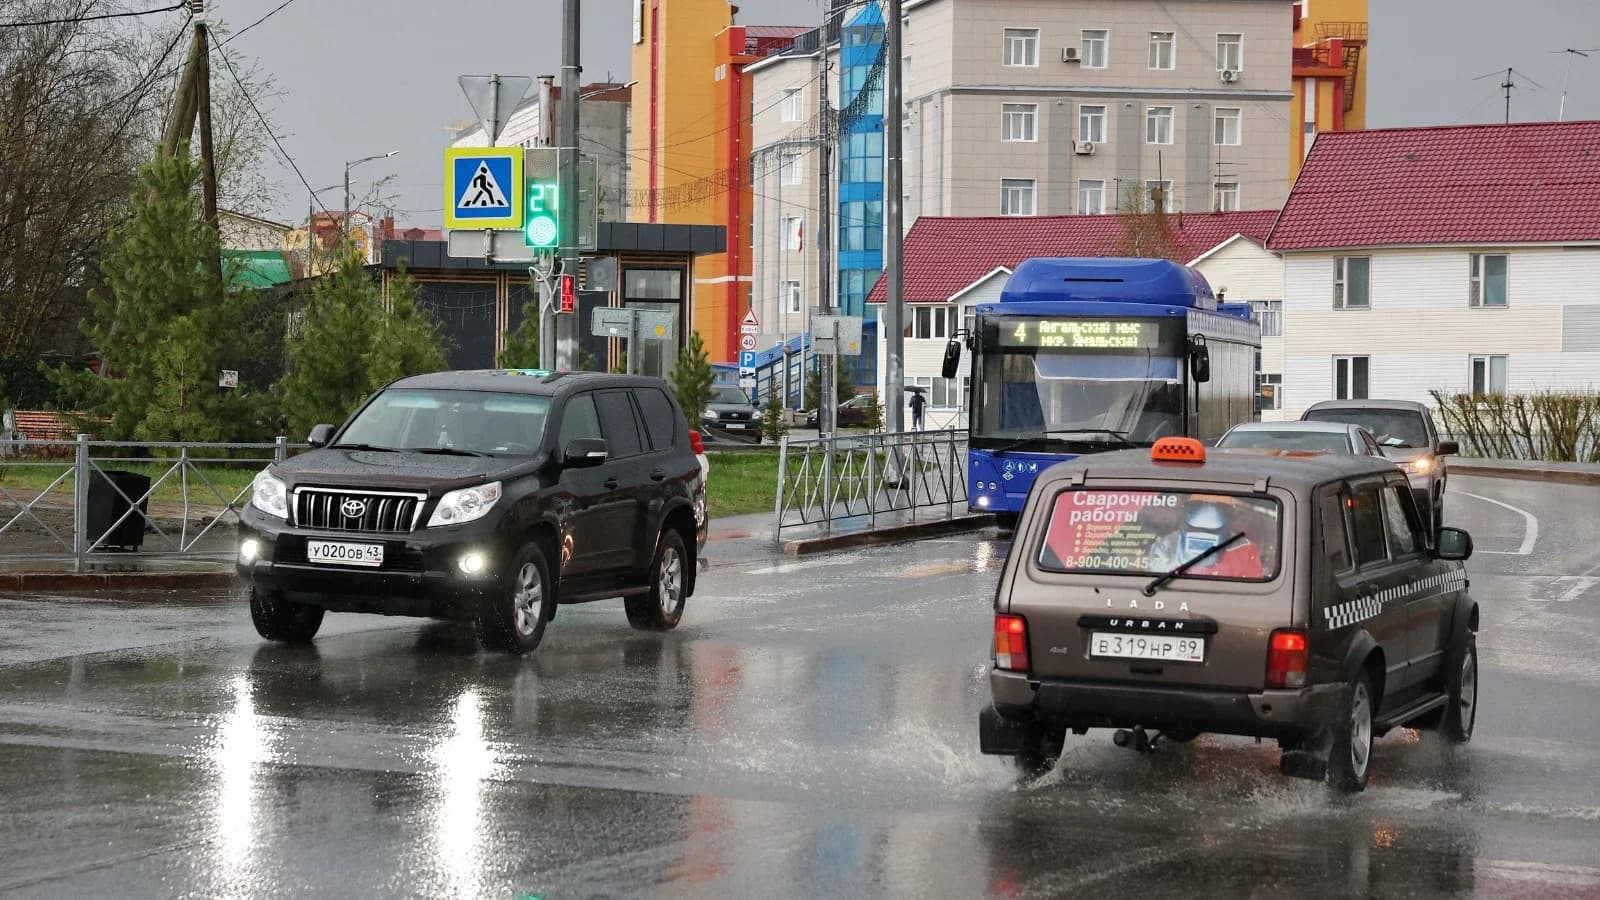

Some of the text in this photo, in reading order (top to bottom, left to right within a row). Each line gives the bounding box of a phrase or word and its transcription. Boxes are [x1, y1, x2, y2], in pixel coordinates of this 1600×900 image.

[530, 184, 559, 211] 27
[1013, 322, 1027, 342] 4
[1073, 490, 1178, 509] Сварочные
[1069, 507, 1138, 526] работы
[1106, 598, 1189, 612] LADA
[1109, 619, 1184, 630] URBAN
